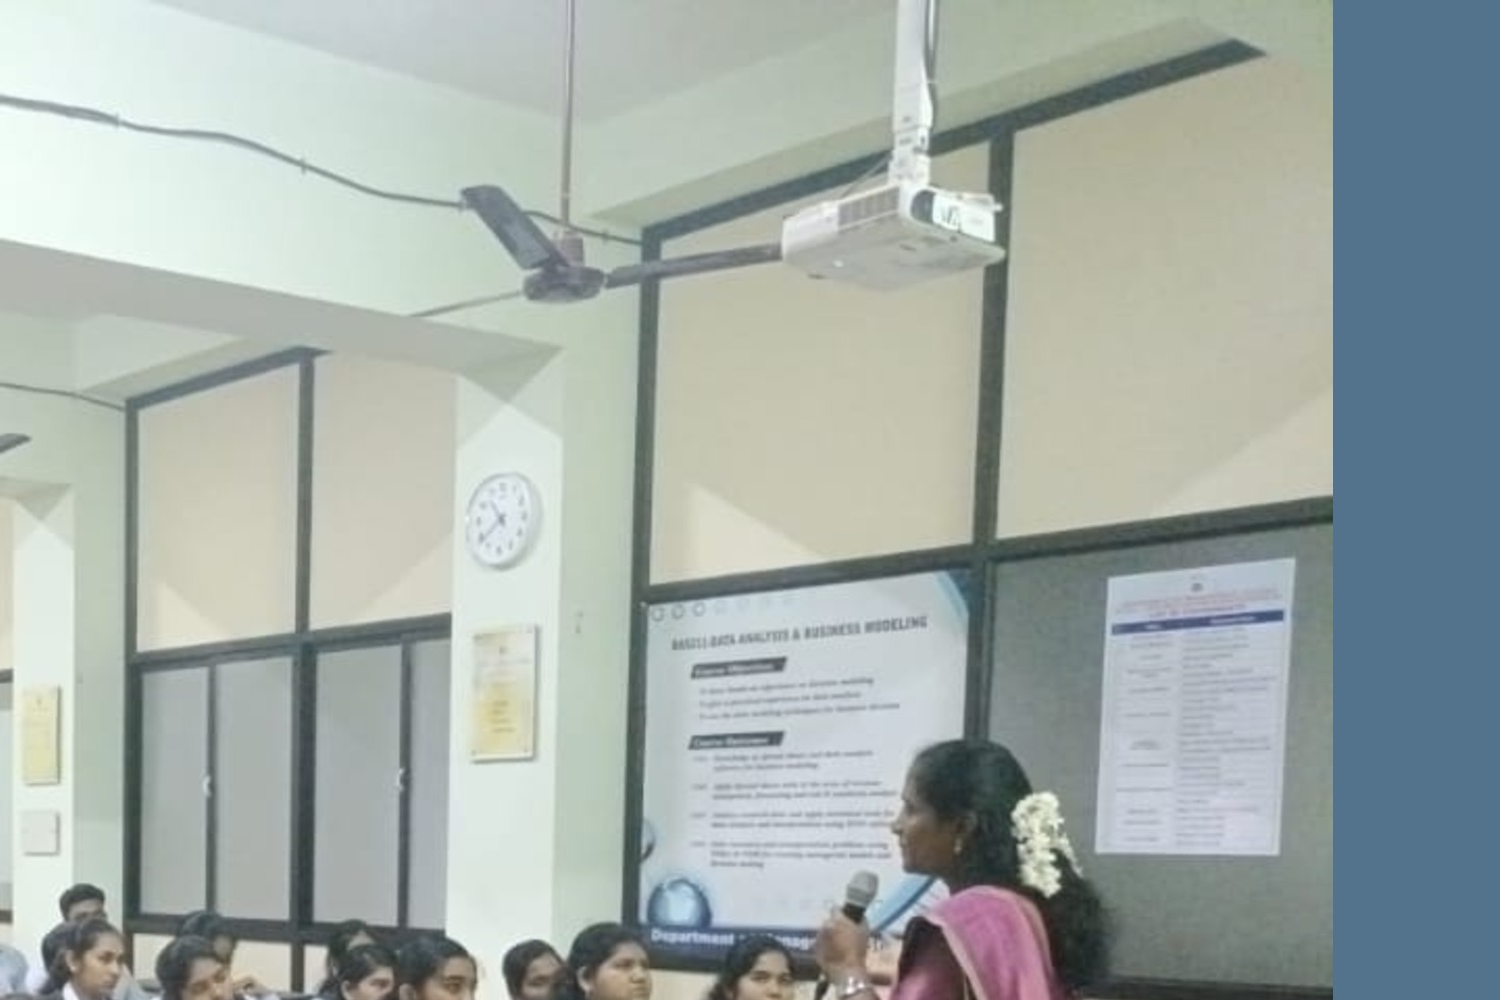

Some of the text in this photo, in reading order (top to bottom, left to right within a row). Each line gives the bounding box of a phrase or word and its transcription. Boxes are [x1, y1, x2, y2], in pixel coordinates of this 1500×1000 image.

[738, 628, 789, 645] ANALYSIS
[792, 627, 800, 641] &
[804, 621, 861, 640] BUSINESS
[864, 615, 928, 635] MODELING
[651, 929, 735, 947] Department
